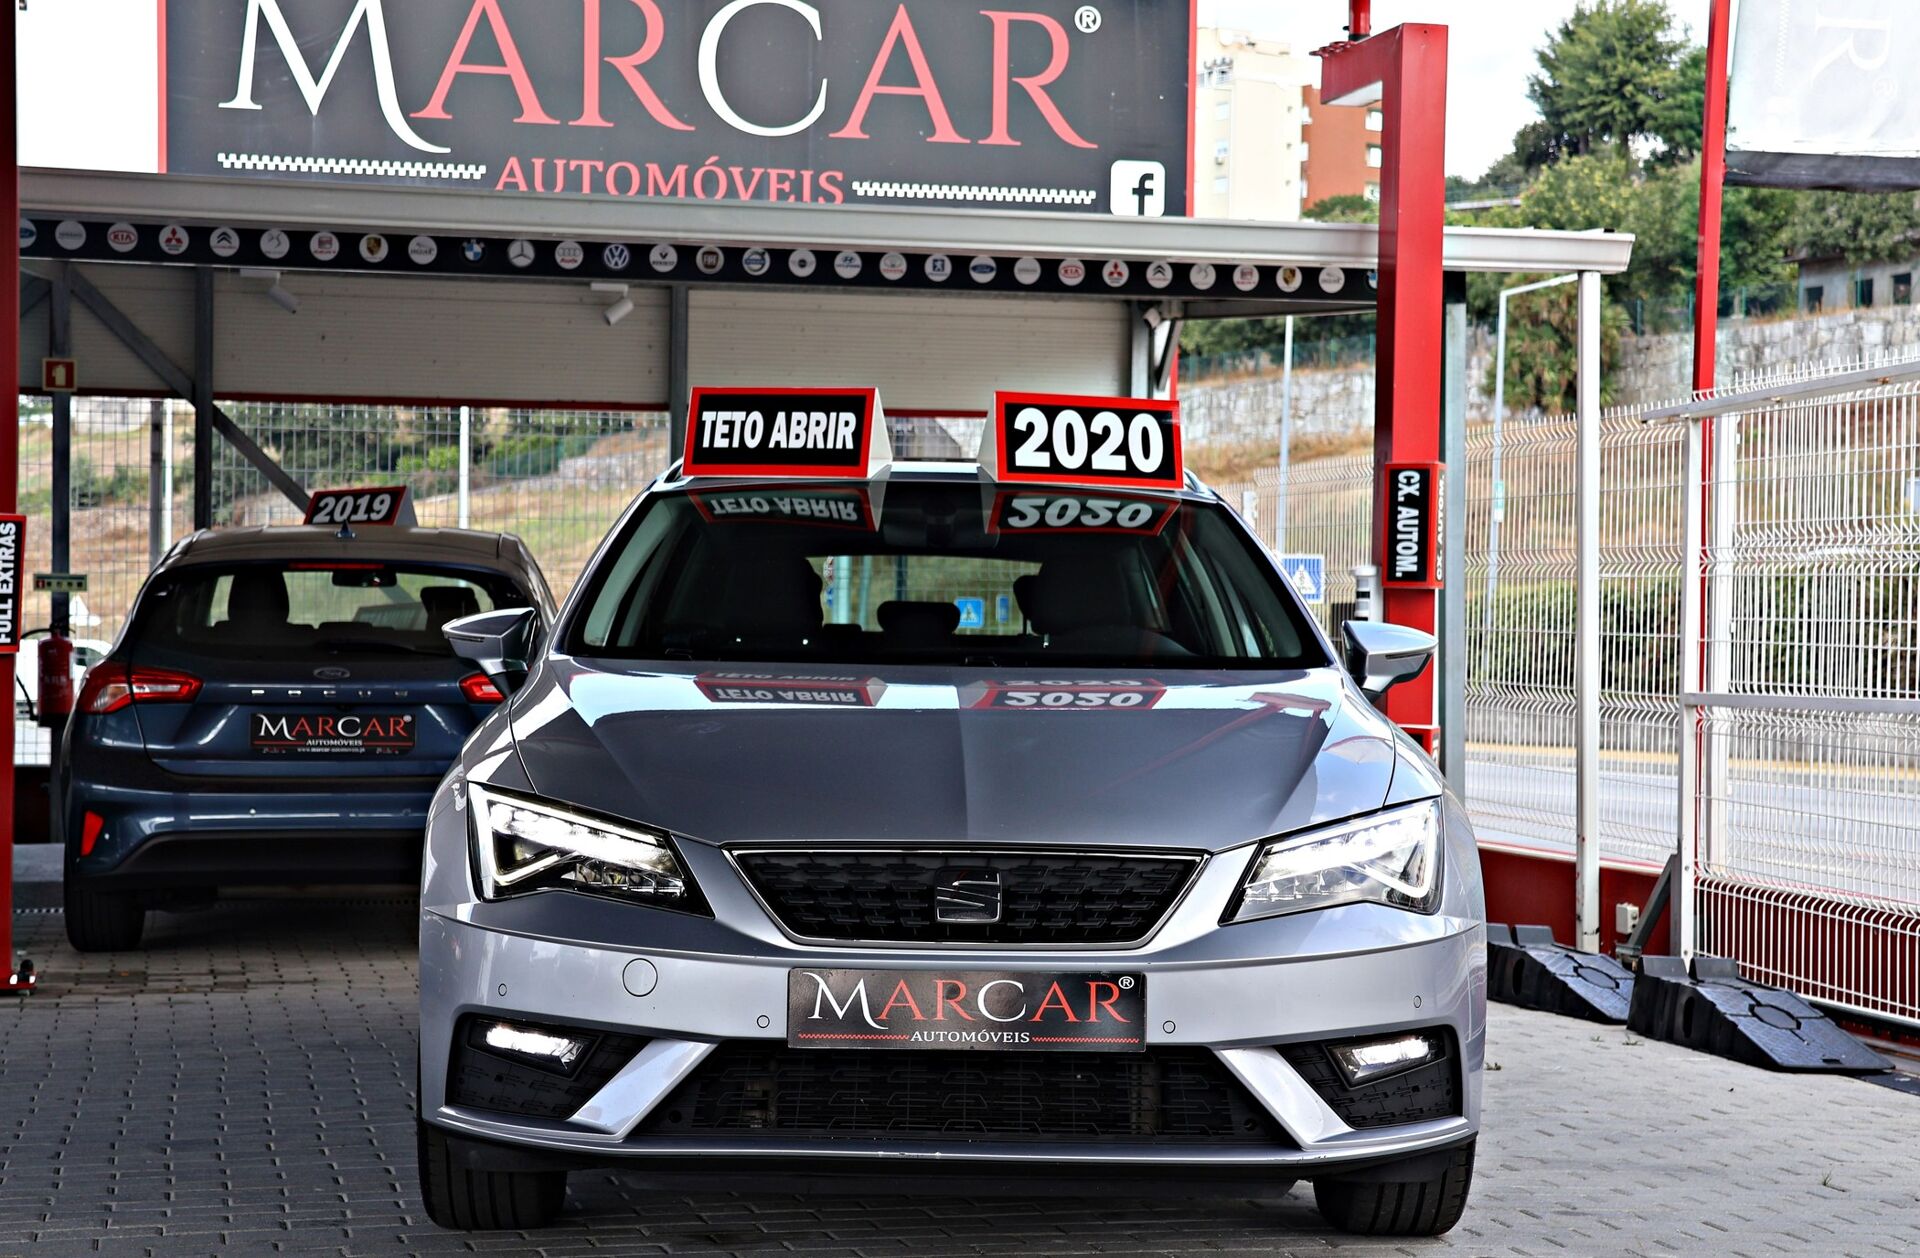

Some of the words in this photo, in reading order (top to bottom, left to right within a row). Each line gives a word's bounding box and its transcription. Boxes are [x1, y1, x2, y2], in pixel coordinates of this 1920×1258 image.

[495, 156, 844, 205] AUTOMÓVEIS
[113, 233, 132, 242] KIA
[701, 411, 763, 448] TETO
[768, 411, 857, 449] ABRIR
[1014, 407, 1164, 473] 2020
[1397, 470, 1421, 503] CX.
[312, 493, 391, 524] 2019
[1395, 507, 1420, 578] AUTOM.
[910, 1029, 1030, 1043] AUTOMÓVEIS
